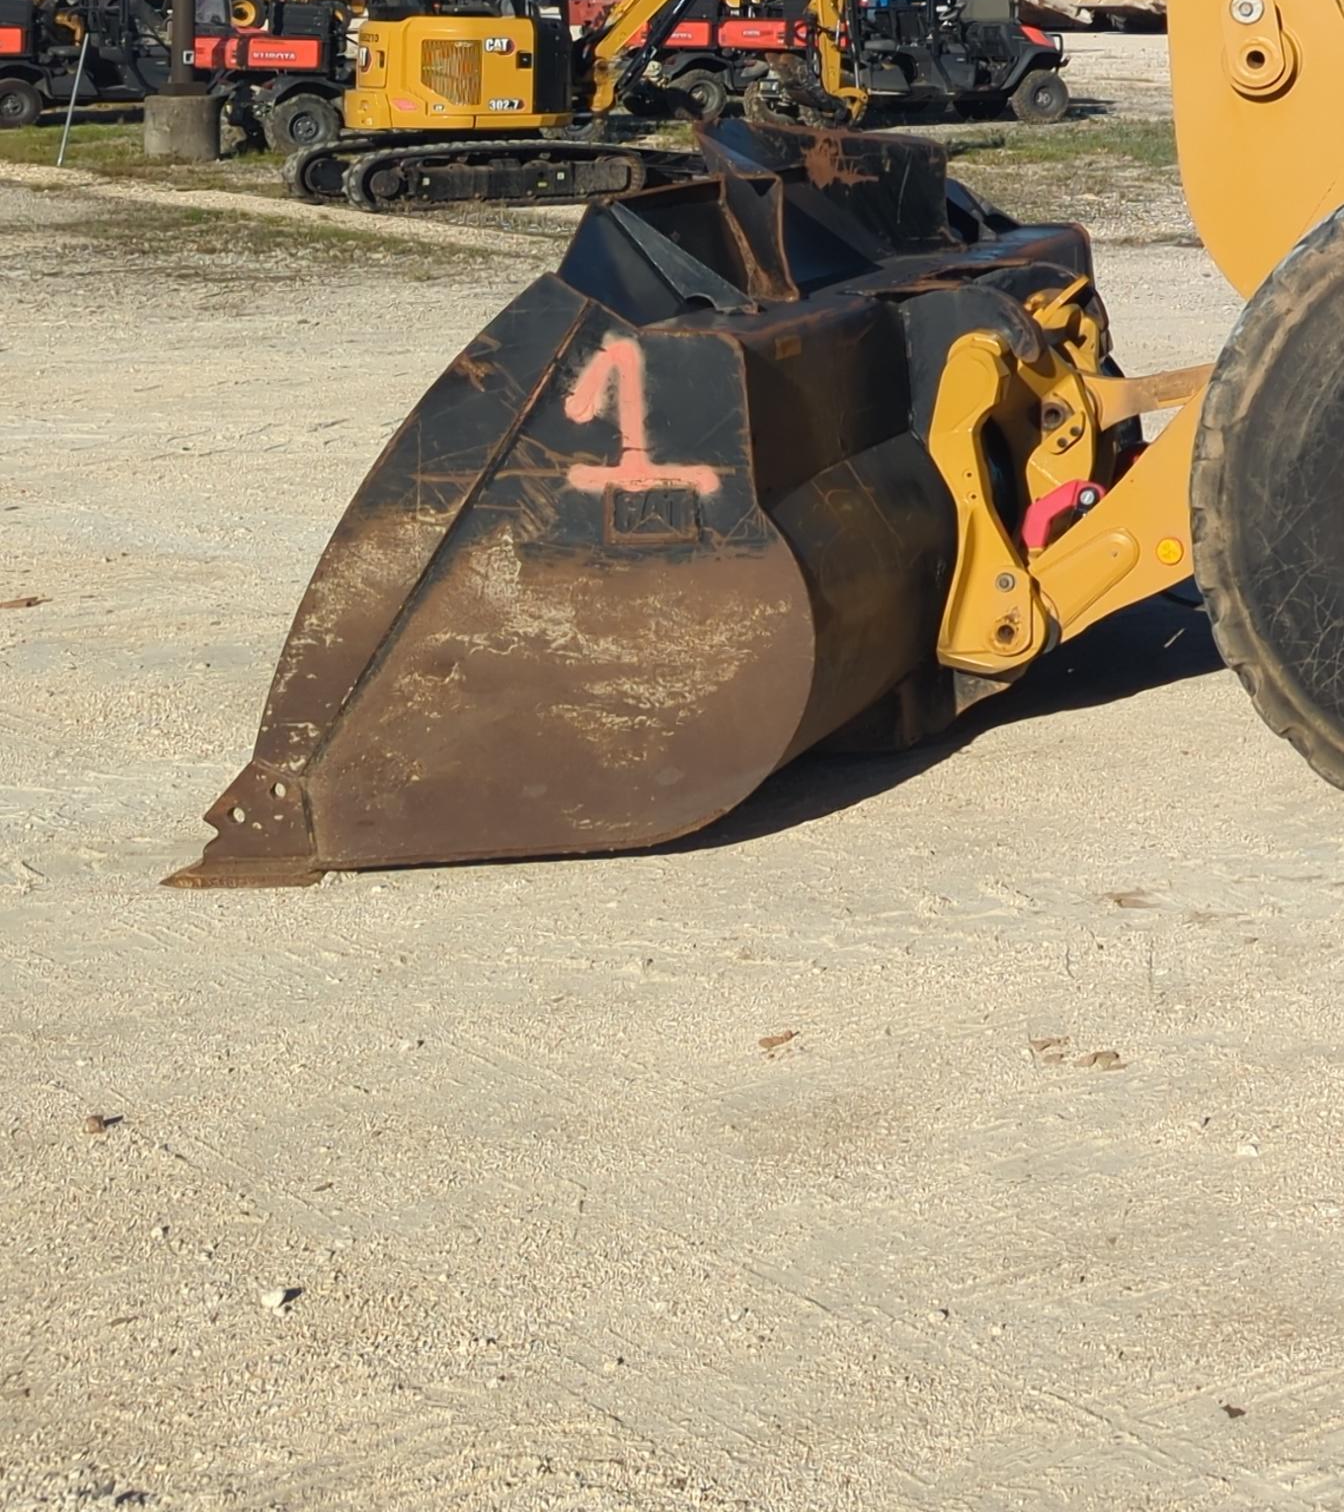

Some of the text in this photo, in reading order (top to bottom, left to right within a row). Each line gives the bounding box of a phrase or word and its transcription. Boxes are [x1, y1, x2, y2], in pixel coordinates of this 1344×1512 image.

[485, 38, 509, 53] CAT
[489, 99, 520, 111] 302.7
[564, 337, 720, 494] 1
